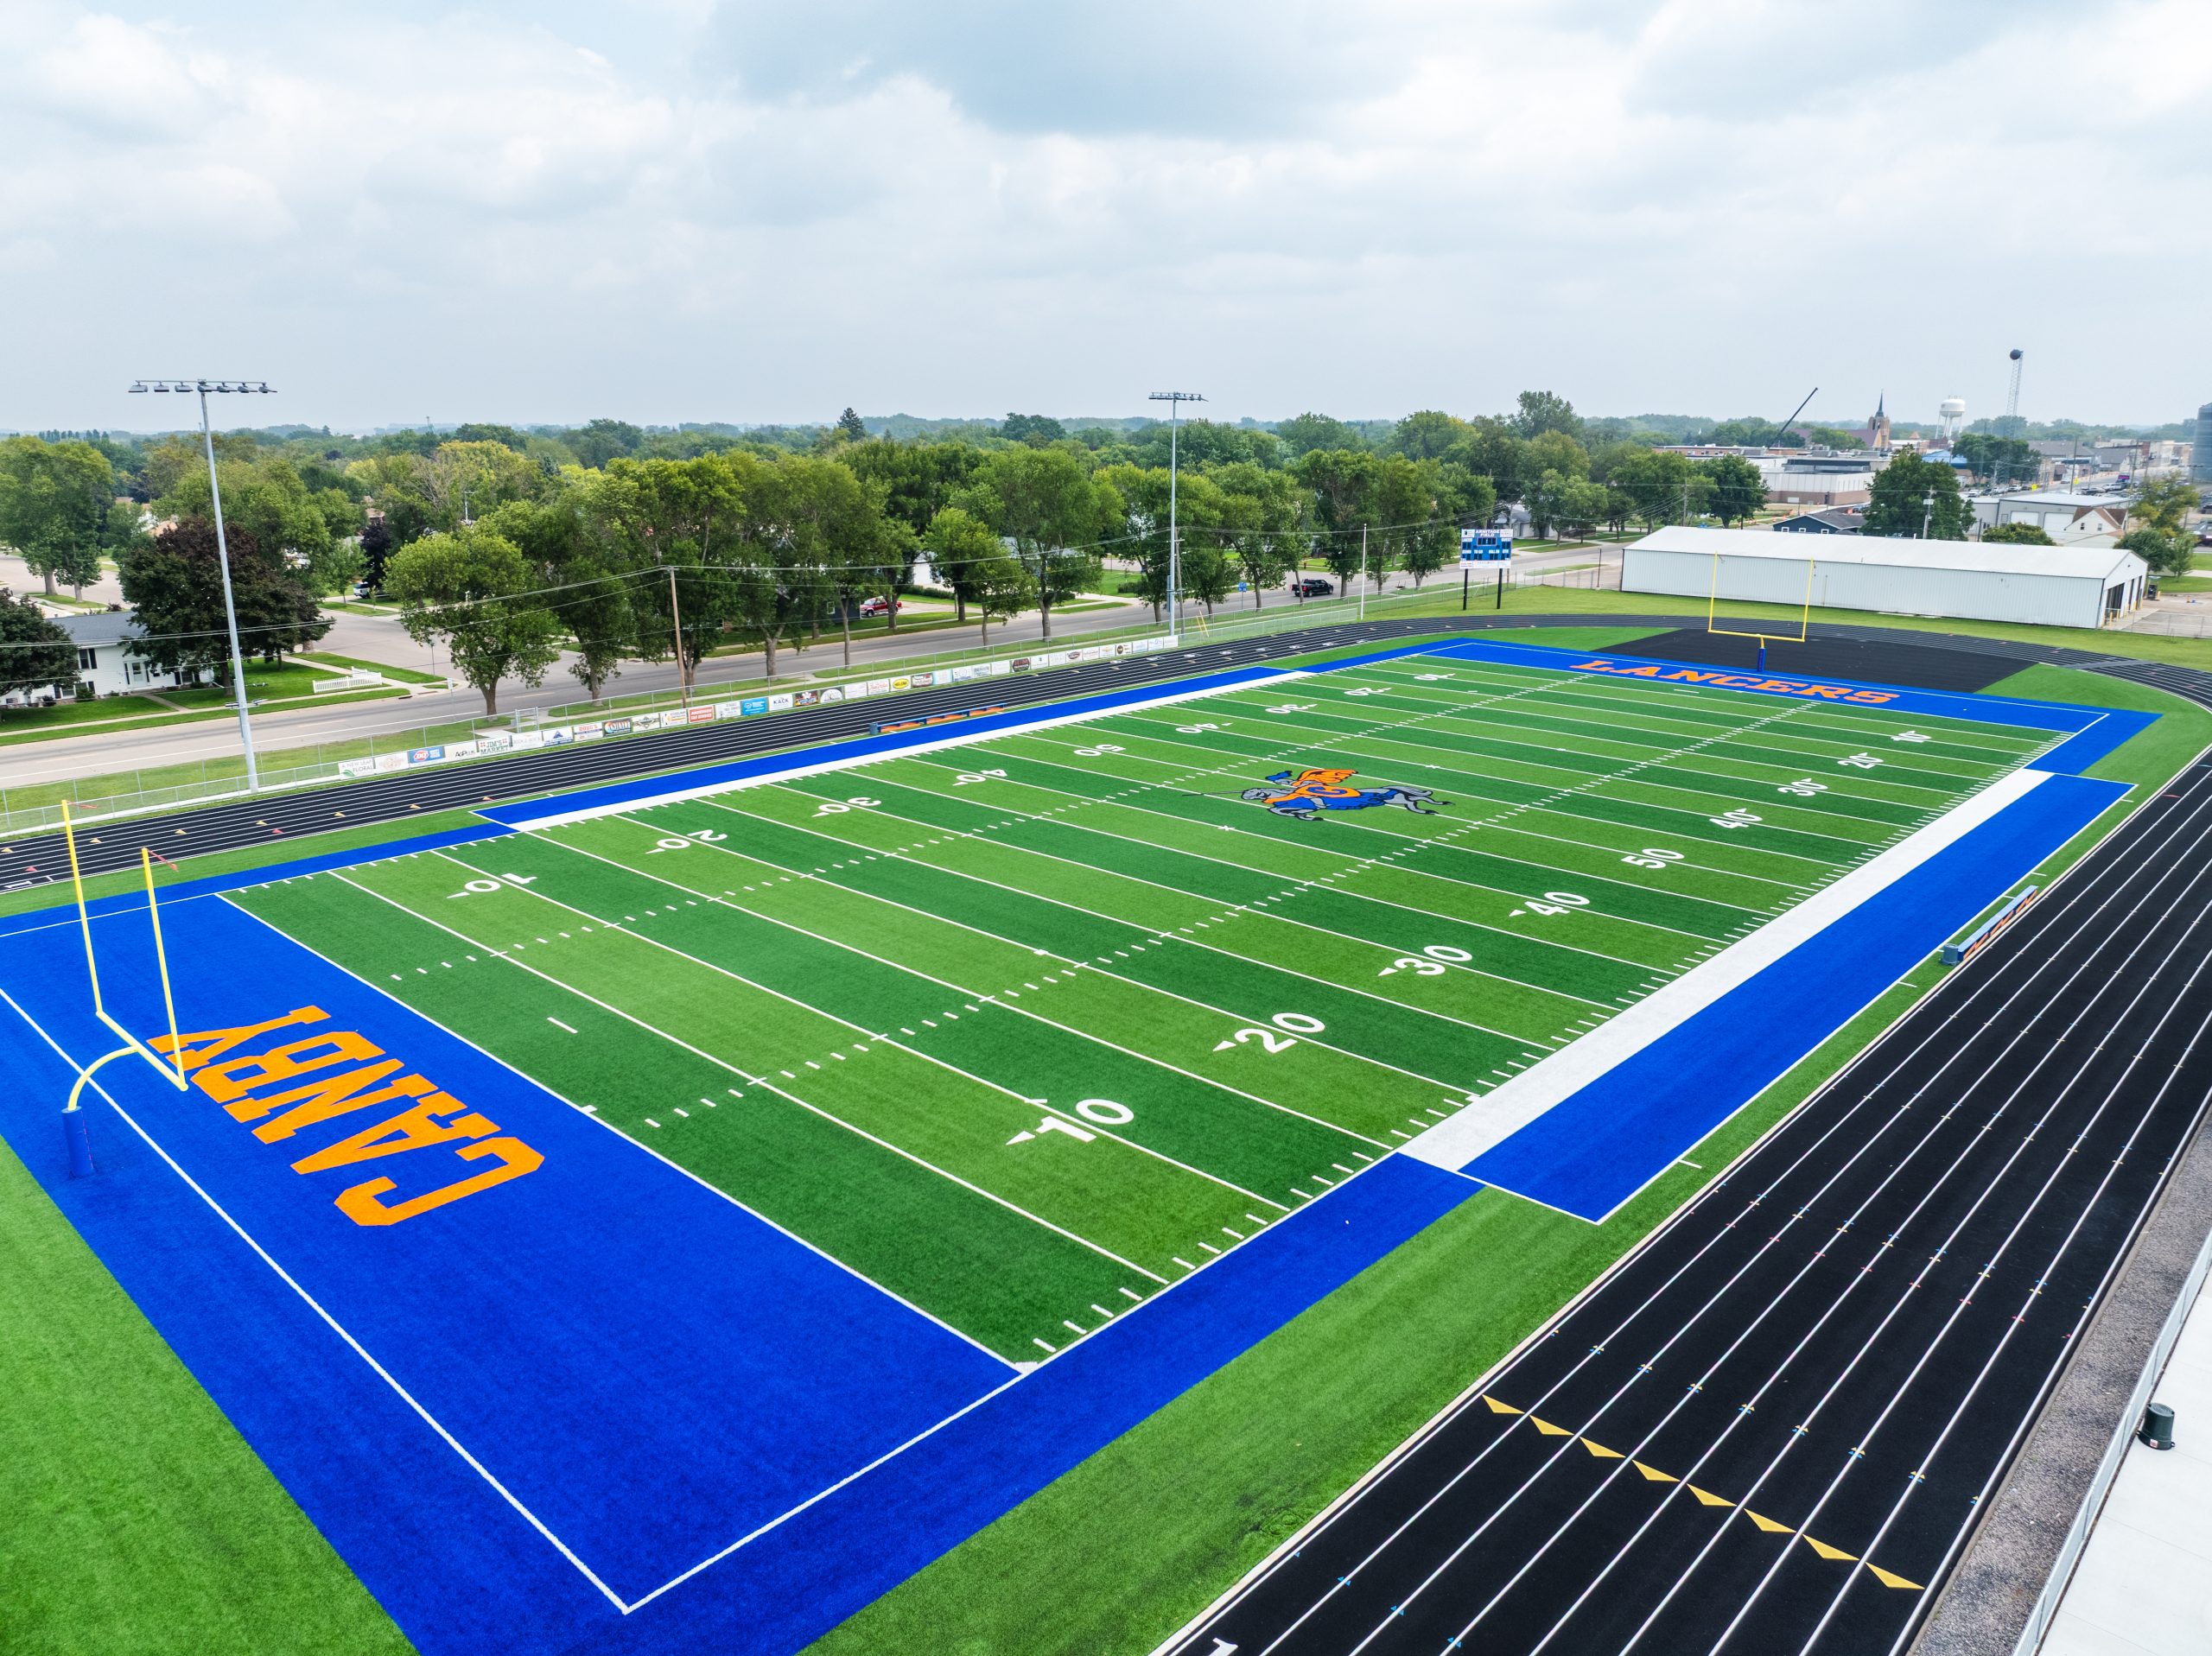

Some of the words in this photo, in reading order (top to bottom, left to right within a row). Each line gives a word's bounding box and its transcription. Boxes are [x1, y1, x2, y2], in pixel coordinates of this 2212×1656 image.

[1569, 660, 1900, 703] LANCERS
[1344, 687, 1385, 696] 20
[1265, 704, 1308, 714] 30
[1175, 722, 1220, 734] 40
[1891, 733, 1932, 743] 10
[480, 745, 508, 755] MARKET
[1073, 744, 1127, 757] 50
[1837, 754, 1884, 769] 20
[956, 768, 1008, 784] 40
[1777, 781, 1828, 796] 30
[818, 796, 882, 815] 30
[1709, 810, 1763, 828] 40
[656, 829, 728, 850] 20
[1620, 848, 1685, 869] 50
[464, 872, 537, 893] 10
[1524, 891, 1591, 916] 40
[1394, 945, 1472, 975] 30
[1234, 1012, 1325, 1053] 20
[146, 1005, 544, 1227] CANBY
[1035, 1098, 1135, 1143] 10
